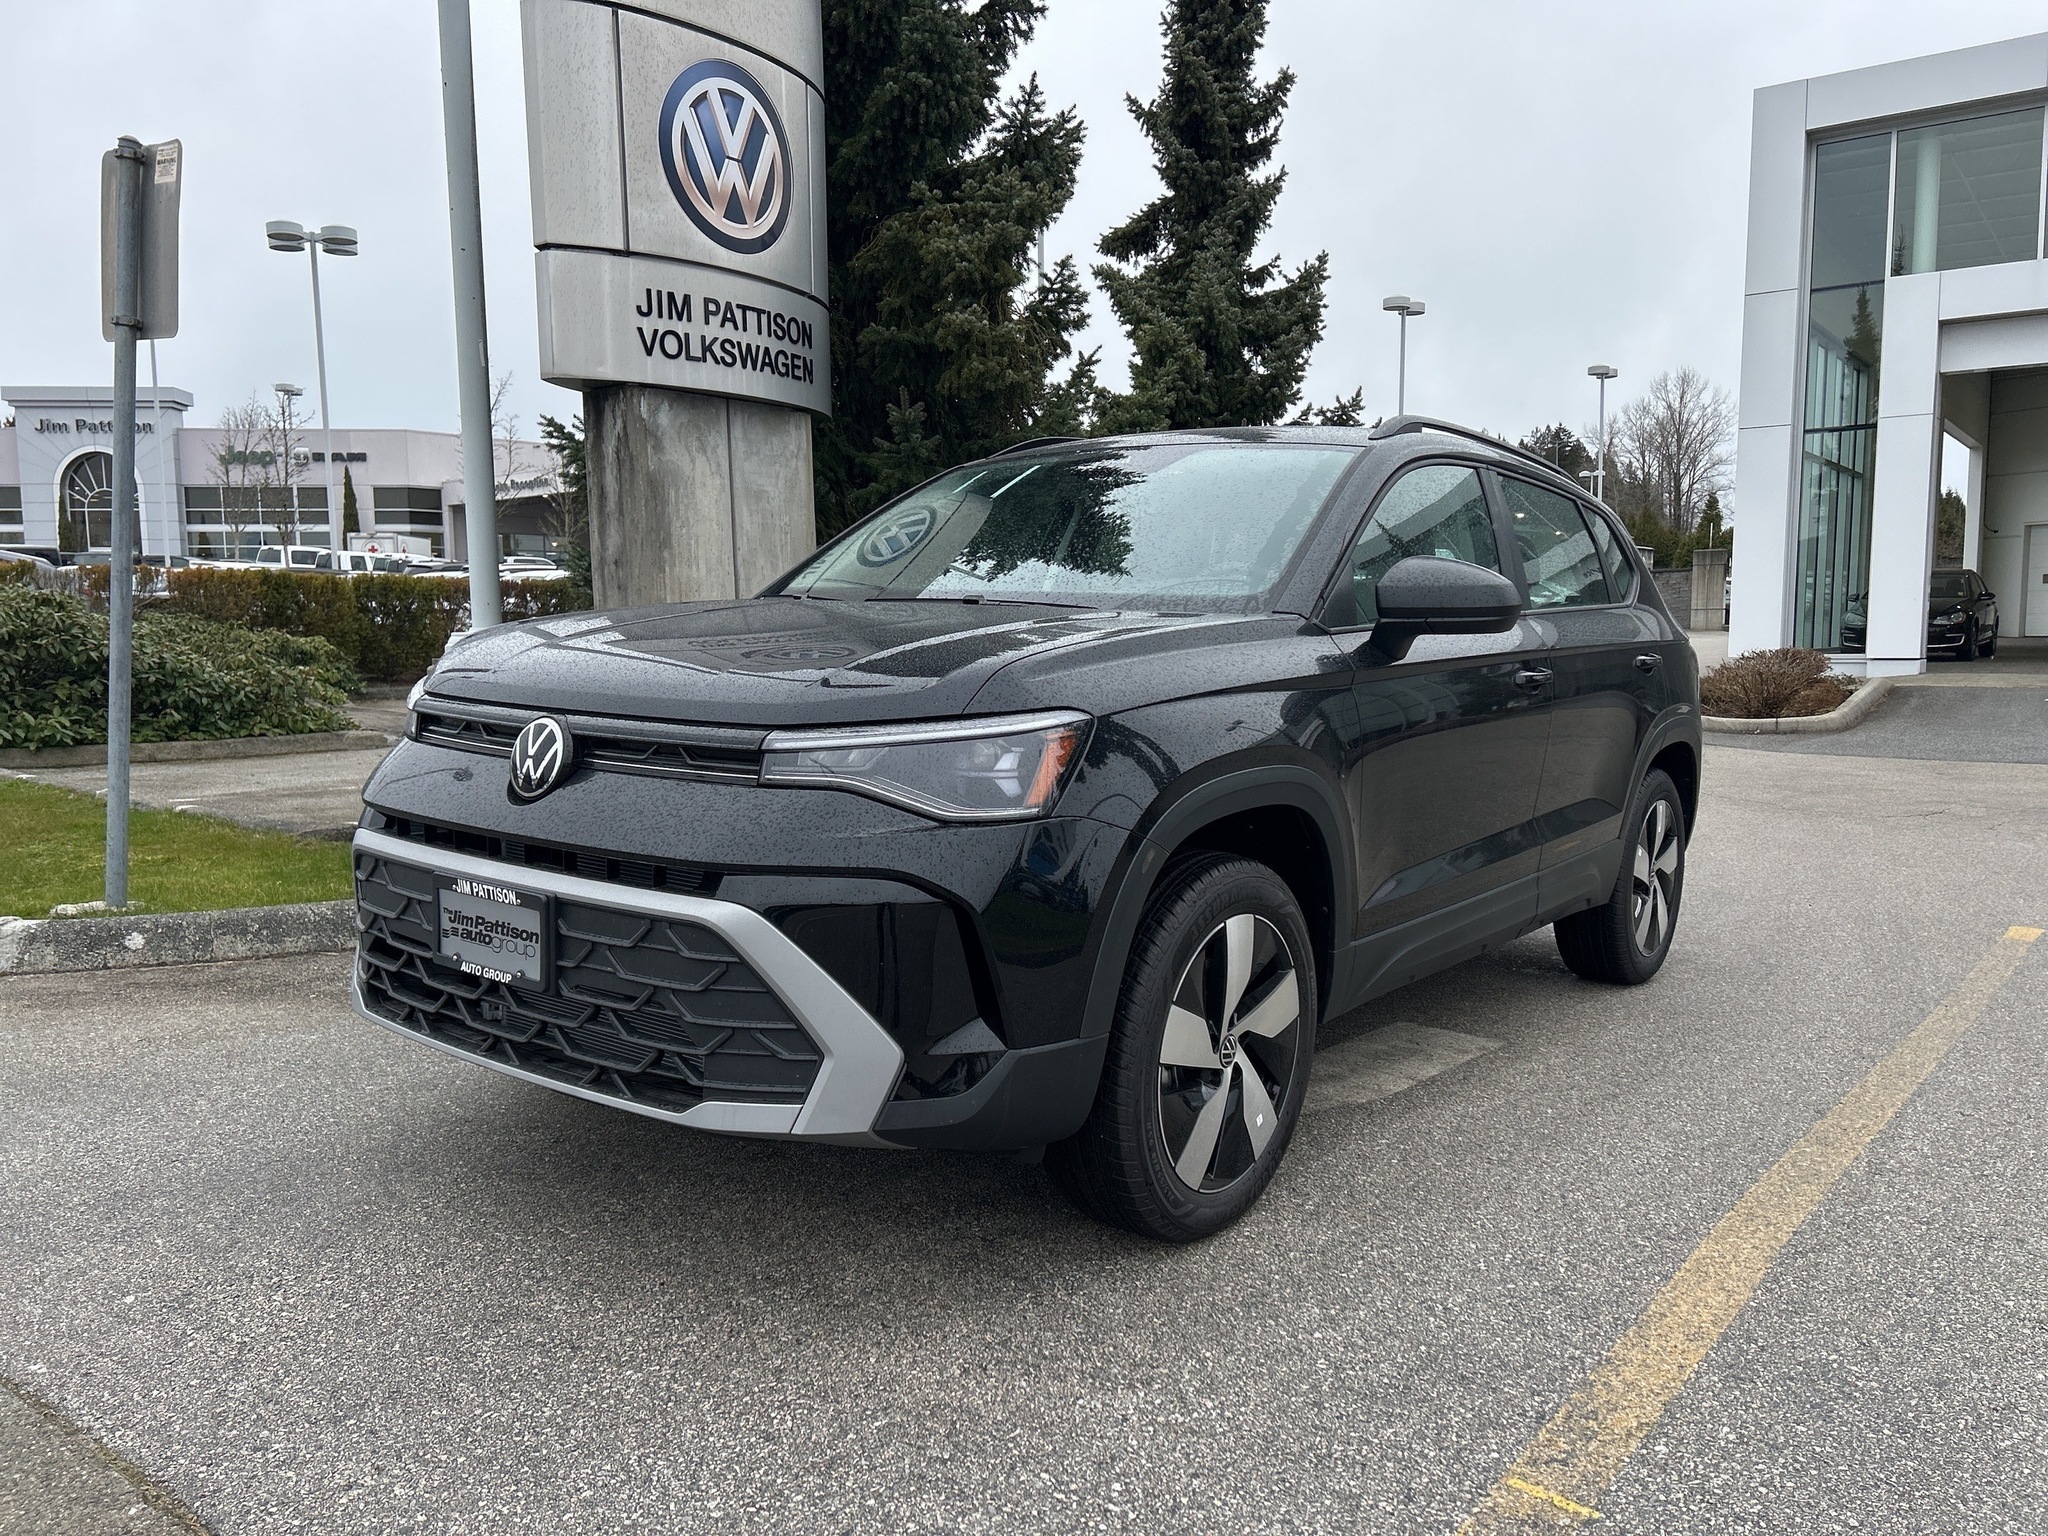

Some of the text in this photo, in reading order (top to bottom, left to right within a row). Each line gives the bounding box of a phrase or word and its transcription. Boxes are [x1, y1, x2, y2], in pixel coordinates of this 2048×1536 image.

[636, 288, 813, 350] JIM PATTISON
[637, 326, 814, 385] VOLKSWAGEN
[34, 418, 155, 434] Jim Patton
[220, 445, 275, 468] Jeep
[455, 879, 517, 905] JIM PATTISON
[442, 906, 454, 916] The
[460, 961, 512, 984] AUTO GROUP
